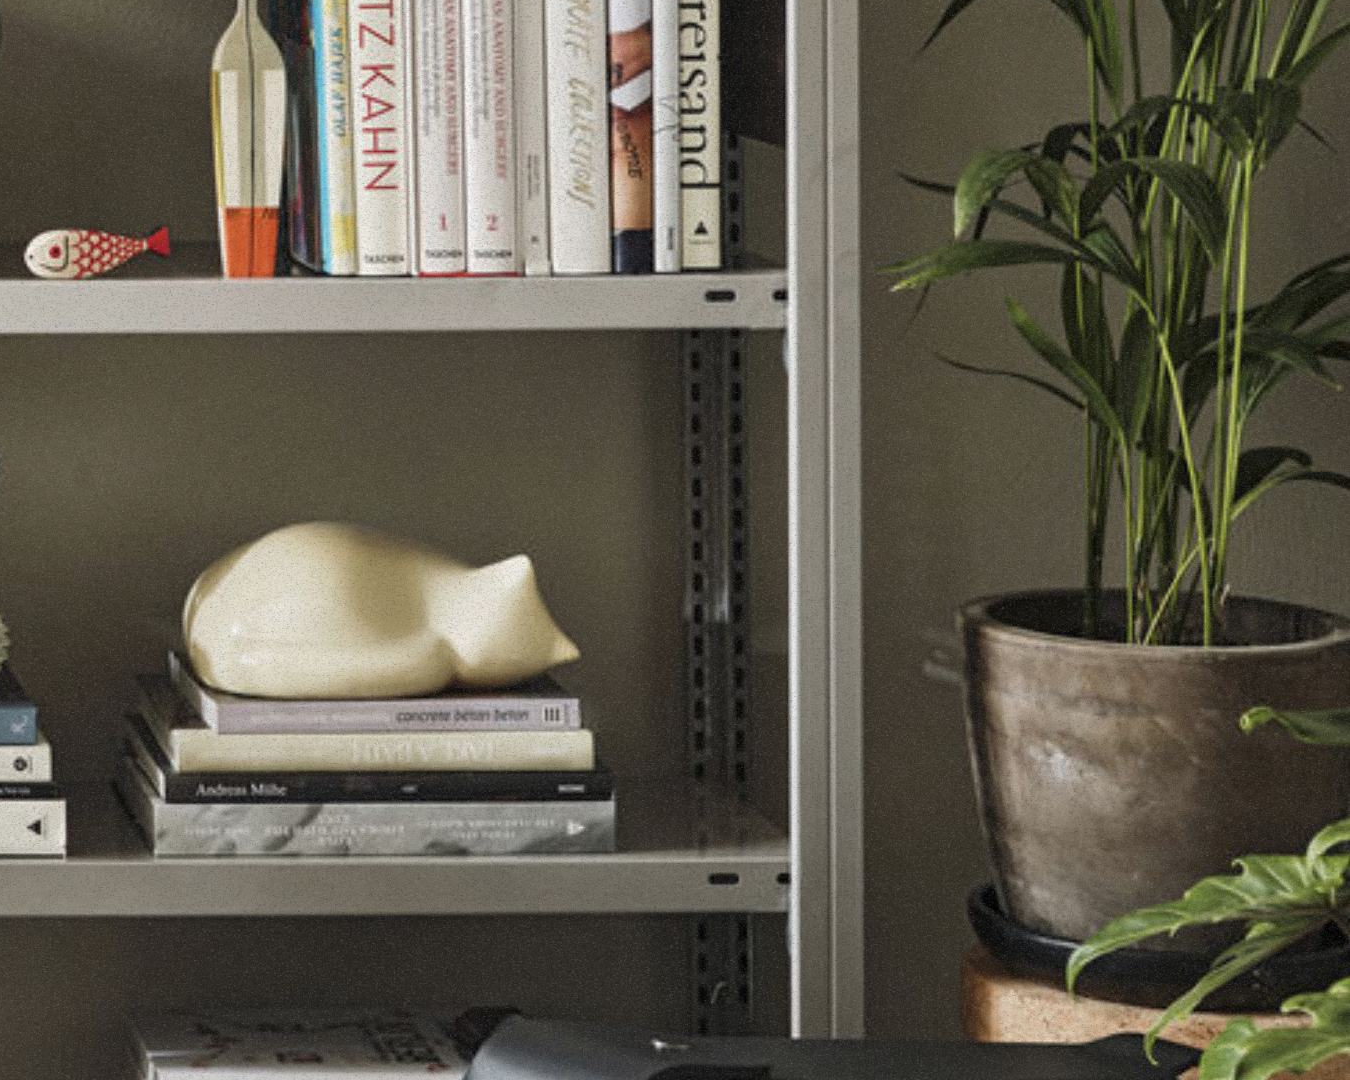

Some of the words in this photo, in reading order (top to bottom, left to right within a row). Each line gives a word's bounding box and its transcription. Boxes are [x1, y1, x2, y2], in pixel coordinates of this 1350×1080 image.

[360, 62, 399, 192] KAHN
[438, 214, 448, 232] 1
[486, 214, 498, 232] 2
[395, 709, 451, 722] concrete
[196, 783, 248, 797] Andreas
